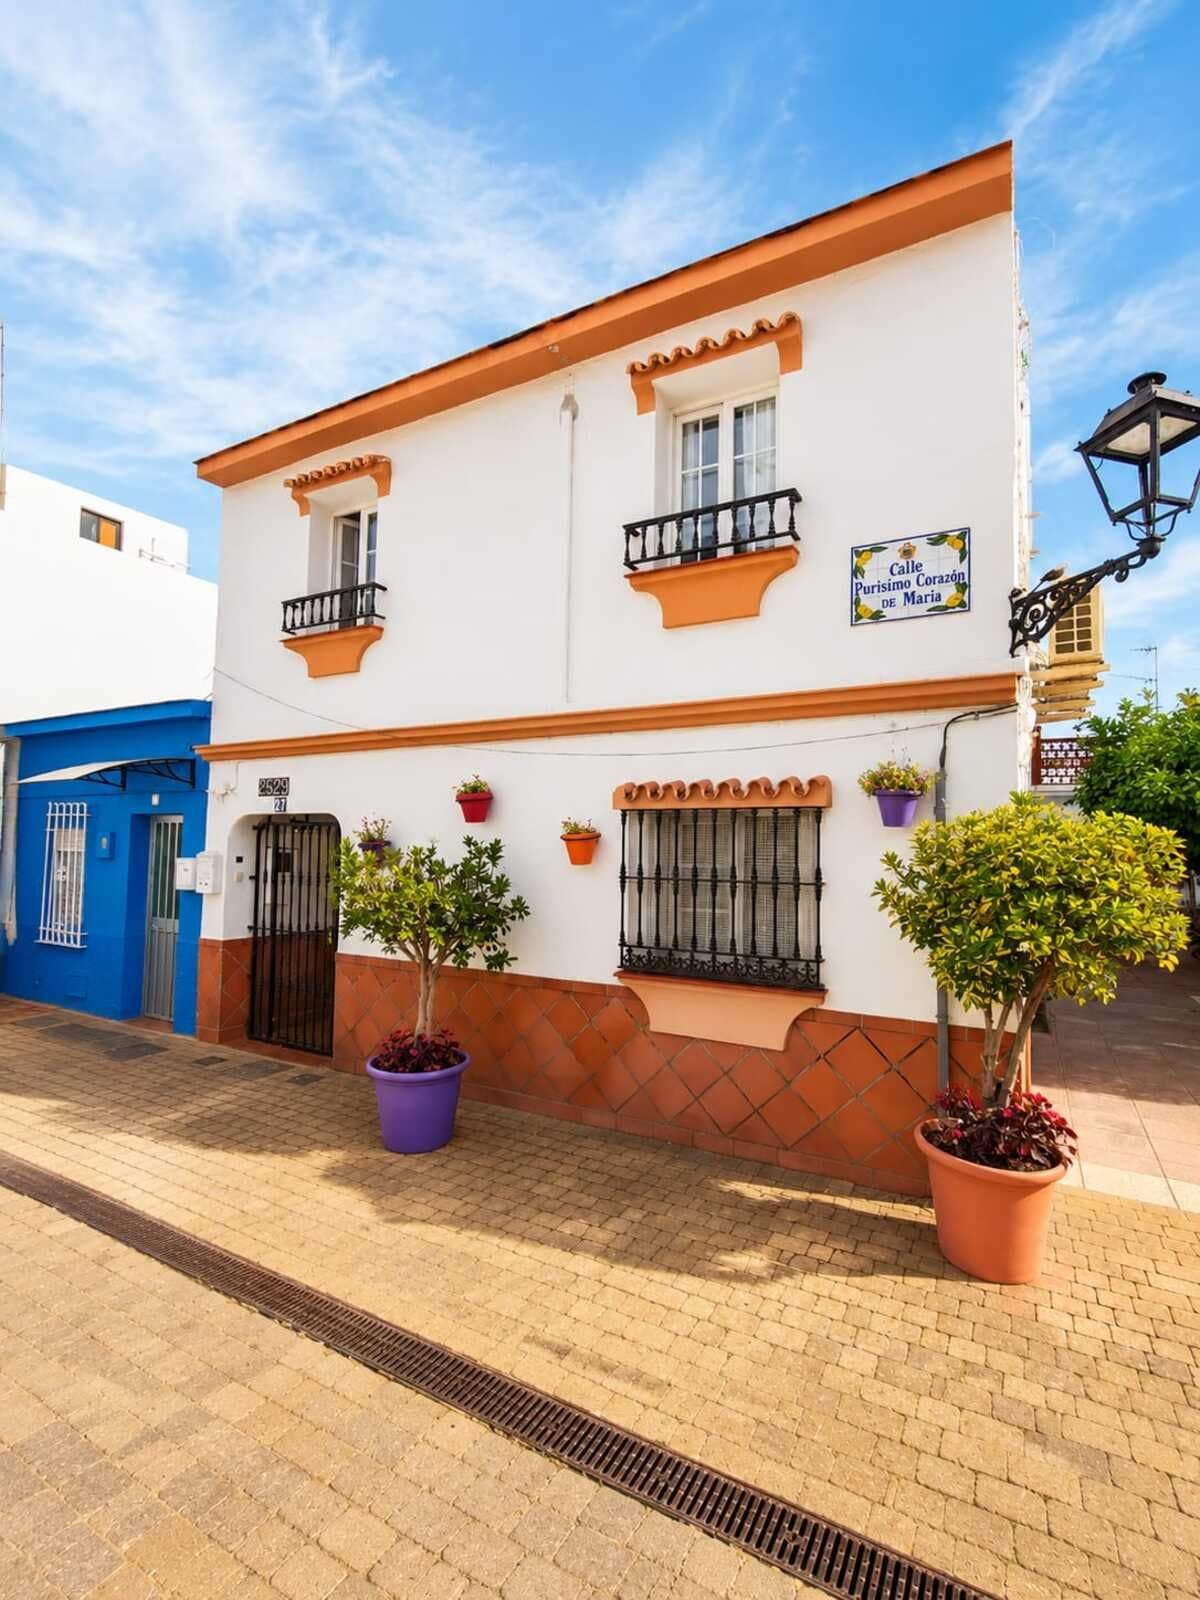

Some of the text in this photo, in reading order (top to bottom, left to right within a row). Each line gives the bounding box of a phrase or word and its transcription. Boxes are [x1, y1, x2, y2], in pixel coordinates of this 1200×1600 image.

[890, 560, 923, 576] Calle
[916, 569, 965, 587] Corazón
[882, 598, 896, 608] DE
[259, 778, 288, 795] 2529
